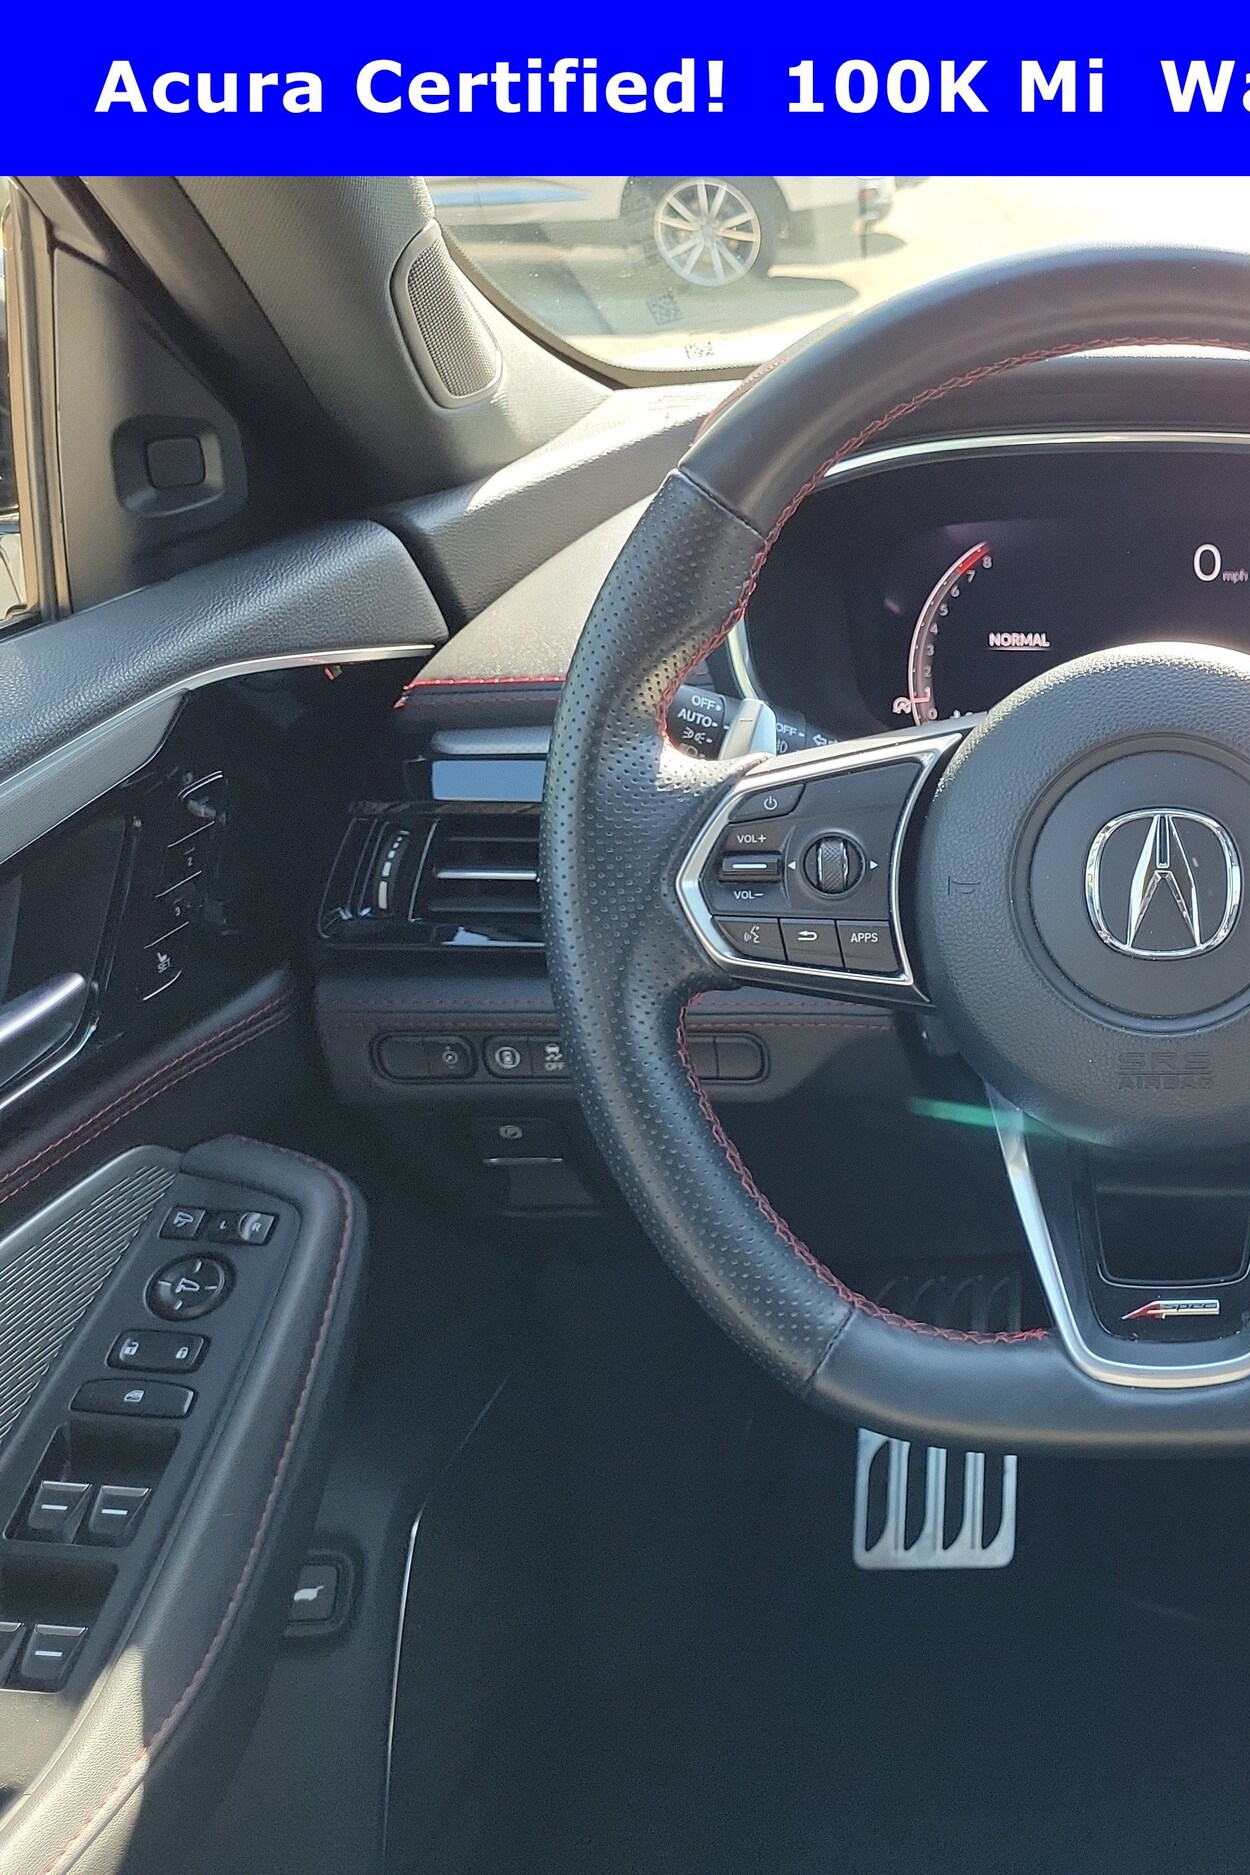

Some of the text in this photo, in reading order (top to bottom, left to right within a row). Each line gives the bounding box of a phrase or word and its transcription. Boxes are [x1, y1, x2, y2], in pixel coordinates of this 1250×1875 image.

[982, 555, 993, 569] 8
[1193, 543, 1249, 584] 0 mph
[965, 569, 976, 583] 7
[950, 584, 960, 598] 6
[938, 602, 949, 616] 5
[929, 623, 939, 635] 4
[988, 632, 1050, 648] NORMAL
[926, 643, 935, 656] 3
[923, 666, 932, 678] 2
[691, 695, 715, 710] OFF
[677, 708, 713, 728] AUTO
[776, 722, 798, 736] OFF
[737, 834, 767, 844] VOL+
[850, 931, 878, 943] APPS
[1119, 1052, 1210, 1070] SRS
[251, 1222, 262, 1233] R
